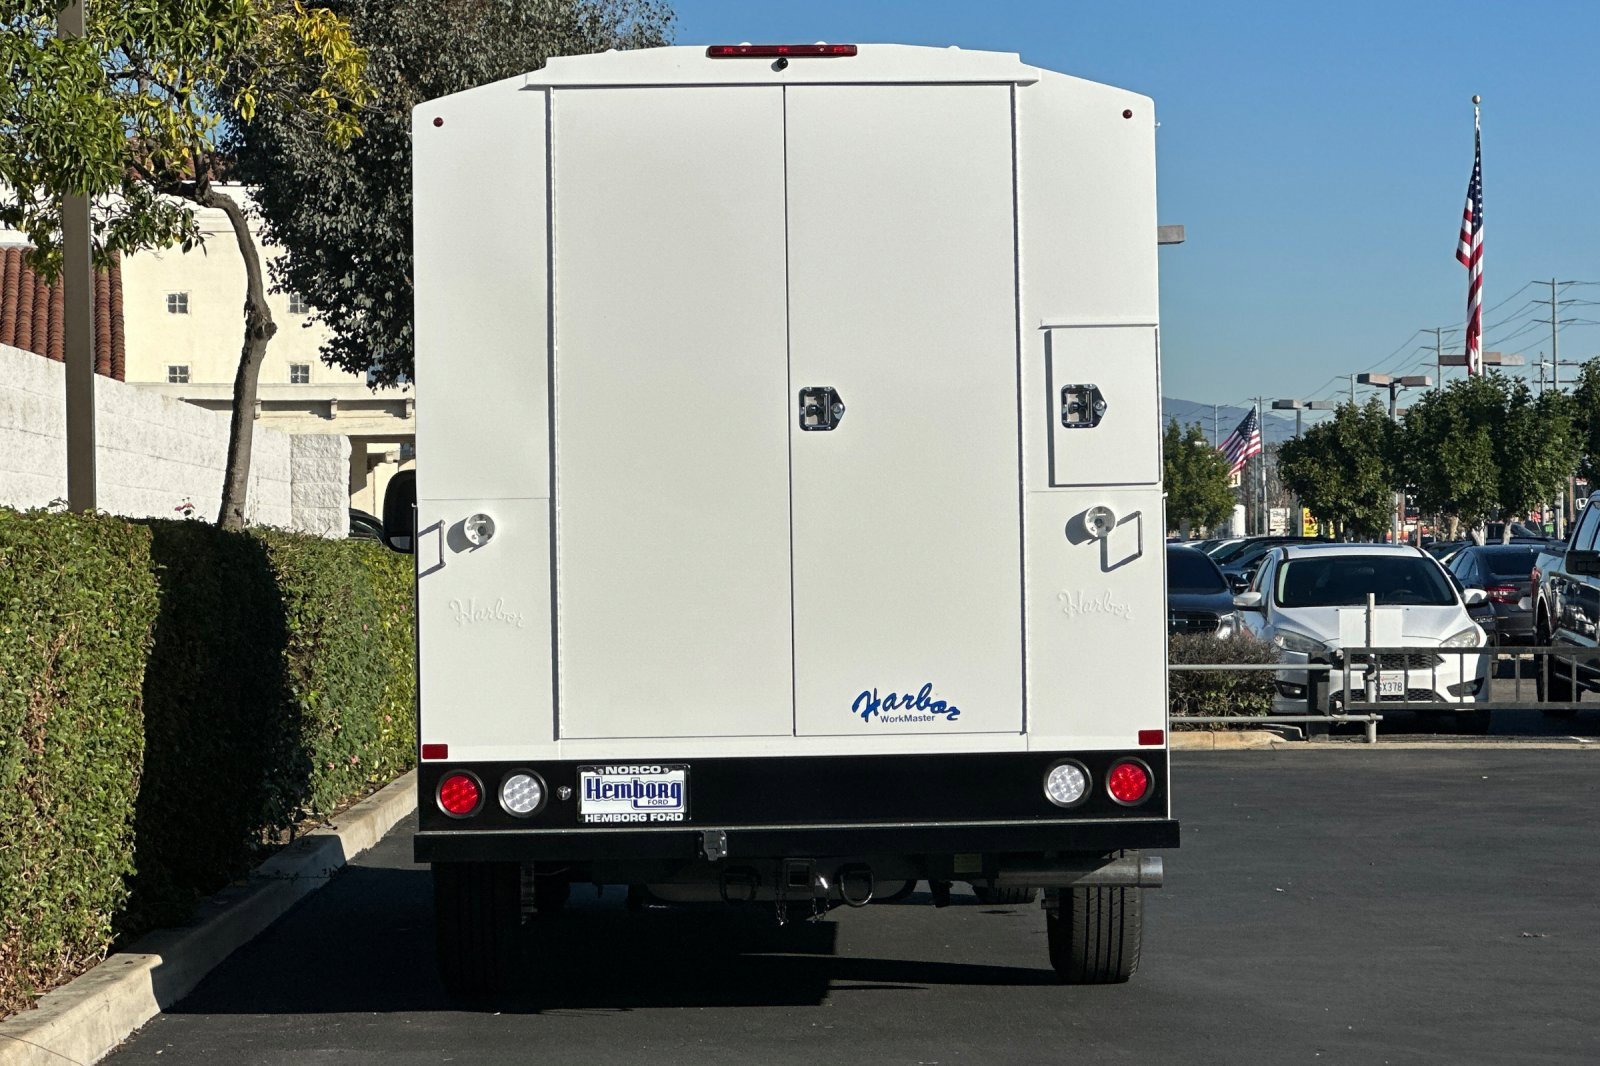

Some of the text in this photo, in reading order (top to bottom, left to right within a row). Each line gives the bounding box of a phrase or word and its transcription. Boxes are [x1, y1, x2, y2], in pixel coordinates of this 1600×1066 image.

[449, 597, 524, 628] Harbor
[1057, 588, 1135, 620] Harbor
[851, 682, 961, 723] Harbor
[880, 714, 935, 723] WorkMaster
[605, 765, 661, 775] NORCO
[585, 777, 682, 801] Hemborg
[585, 812, 684, 823] HEMBORG FORD
